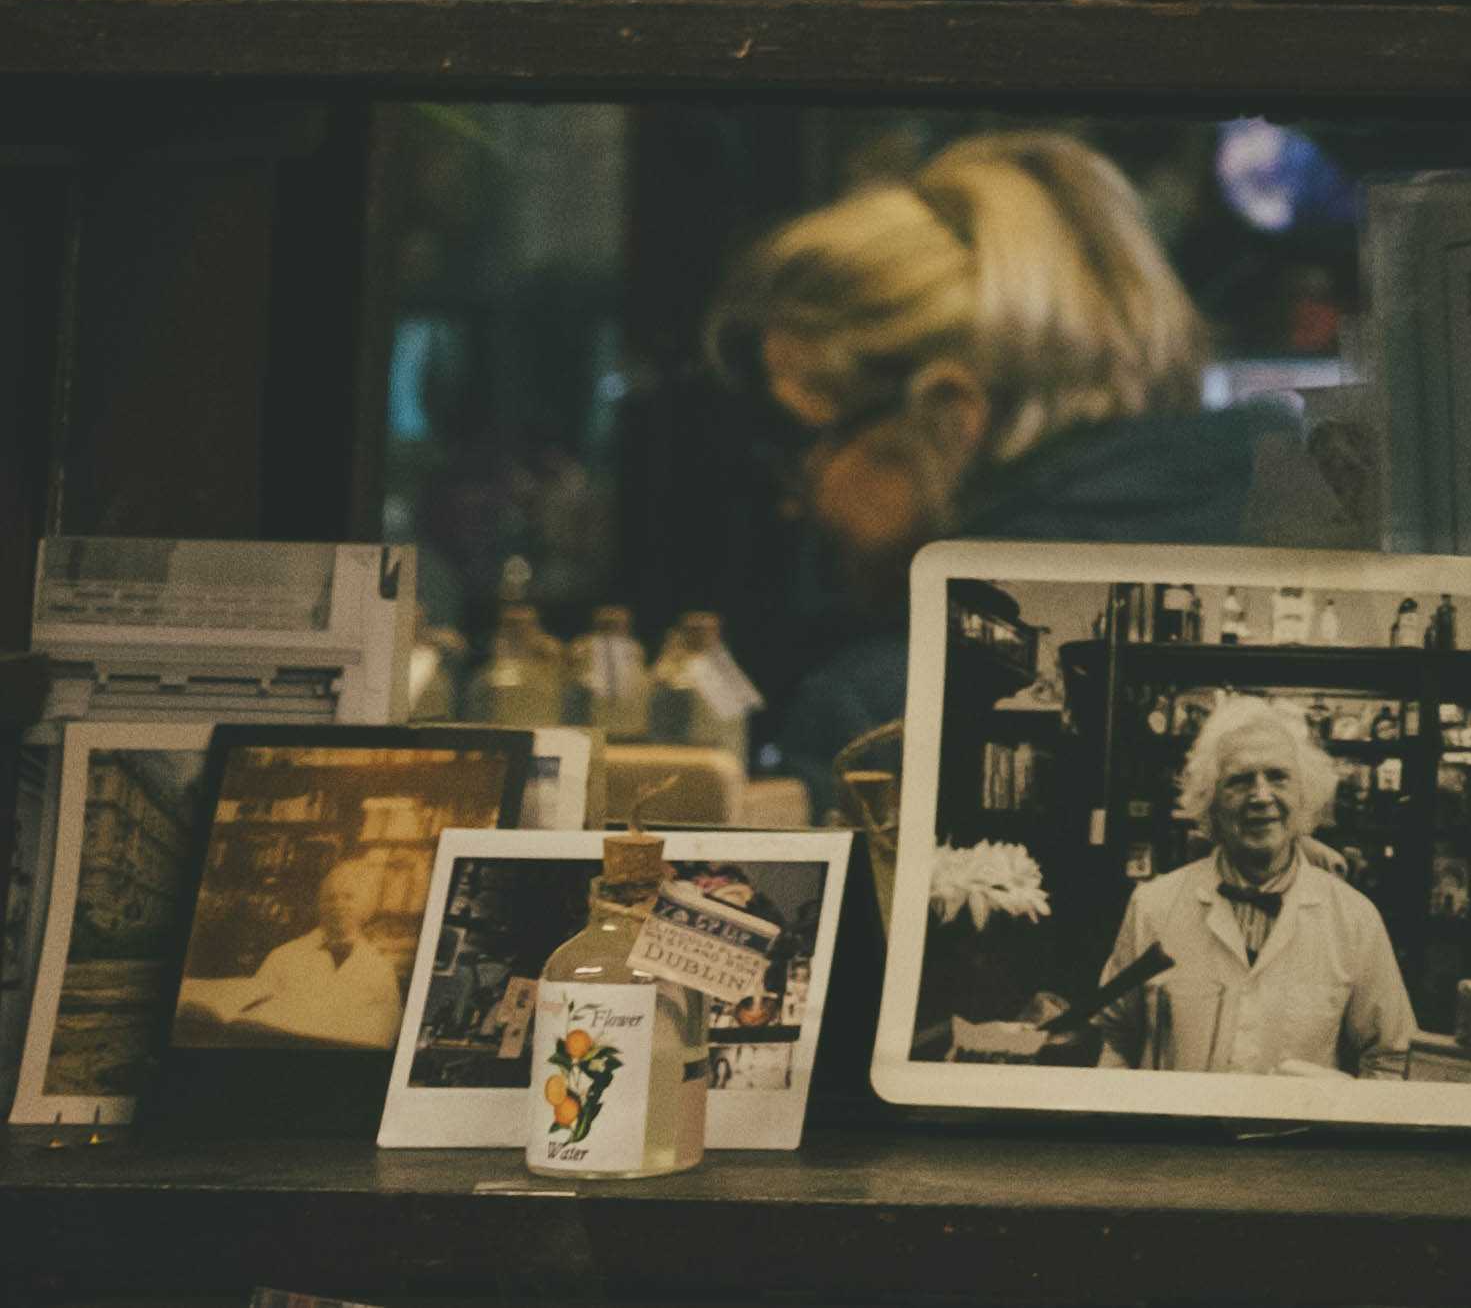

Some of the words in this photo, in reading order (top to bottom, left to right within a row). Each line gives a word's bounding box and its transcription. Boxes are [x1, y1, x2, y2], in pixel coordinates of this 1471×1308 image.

[643, 941, 746, 991] DUBLIN
[591, 1008, 645, 1028] Flower
[547, 1141, 589, 1161] Water
